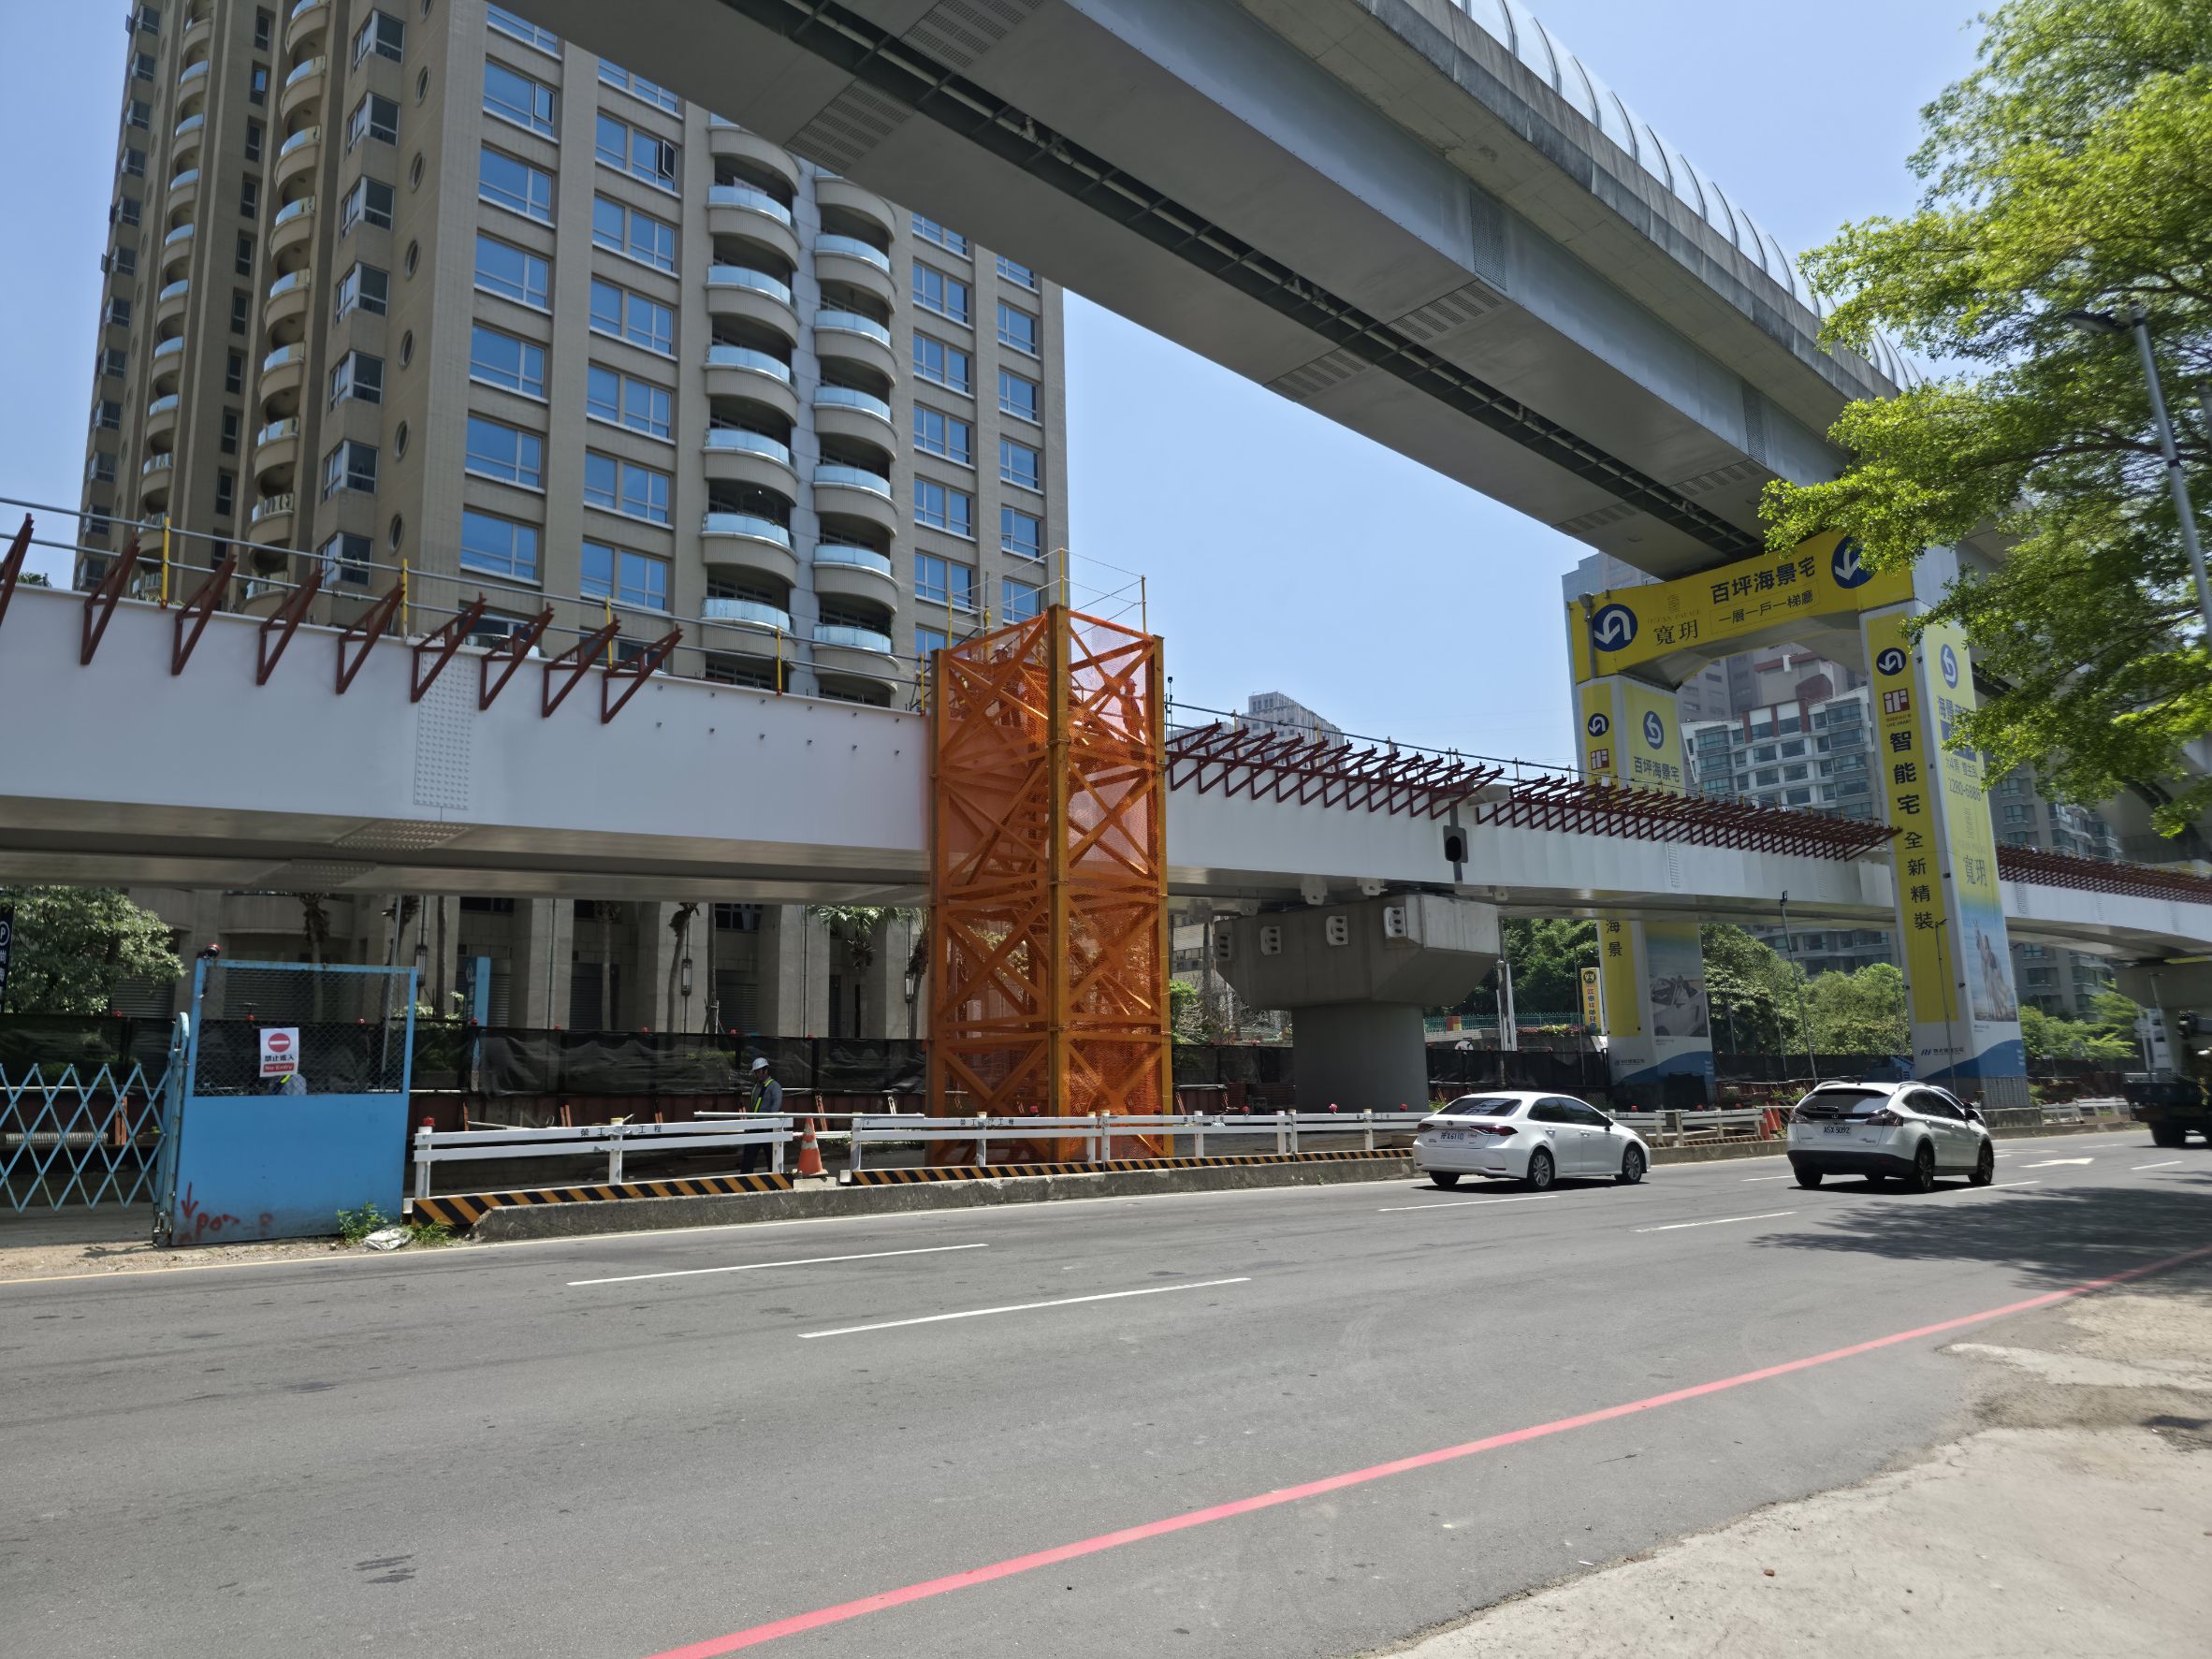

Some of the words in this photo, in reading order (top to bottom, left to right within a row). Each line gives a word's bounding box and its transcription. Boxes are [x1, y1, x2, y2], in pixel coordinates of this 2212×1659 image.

[1710, 556, 1816, 604] 百坪海景宅
[1653, 619, 1698, 646] 寬玥
[1633, 755, 1680, 783] 百坪海景宅
[1890, 730, 1921, 815] 智能宅
[1903, 831, 1934, 930] 全新精裝
[1606, 919, 1623, 957] 海景
[264, 1054, 295, 1063] 禁止進入
[265, 1064, 278, 1072] No
[279, 1063, 294, 1072] Entry
